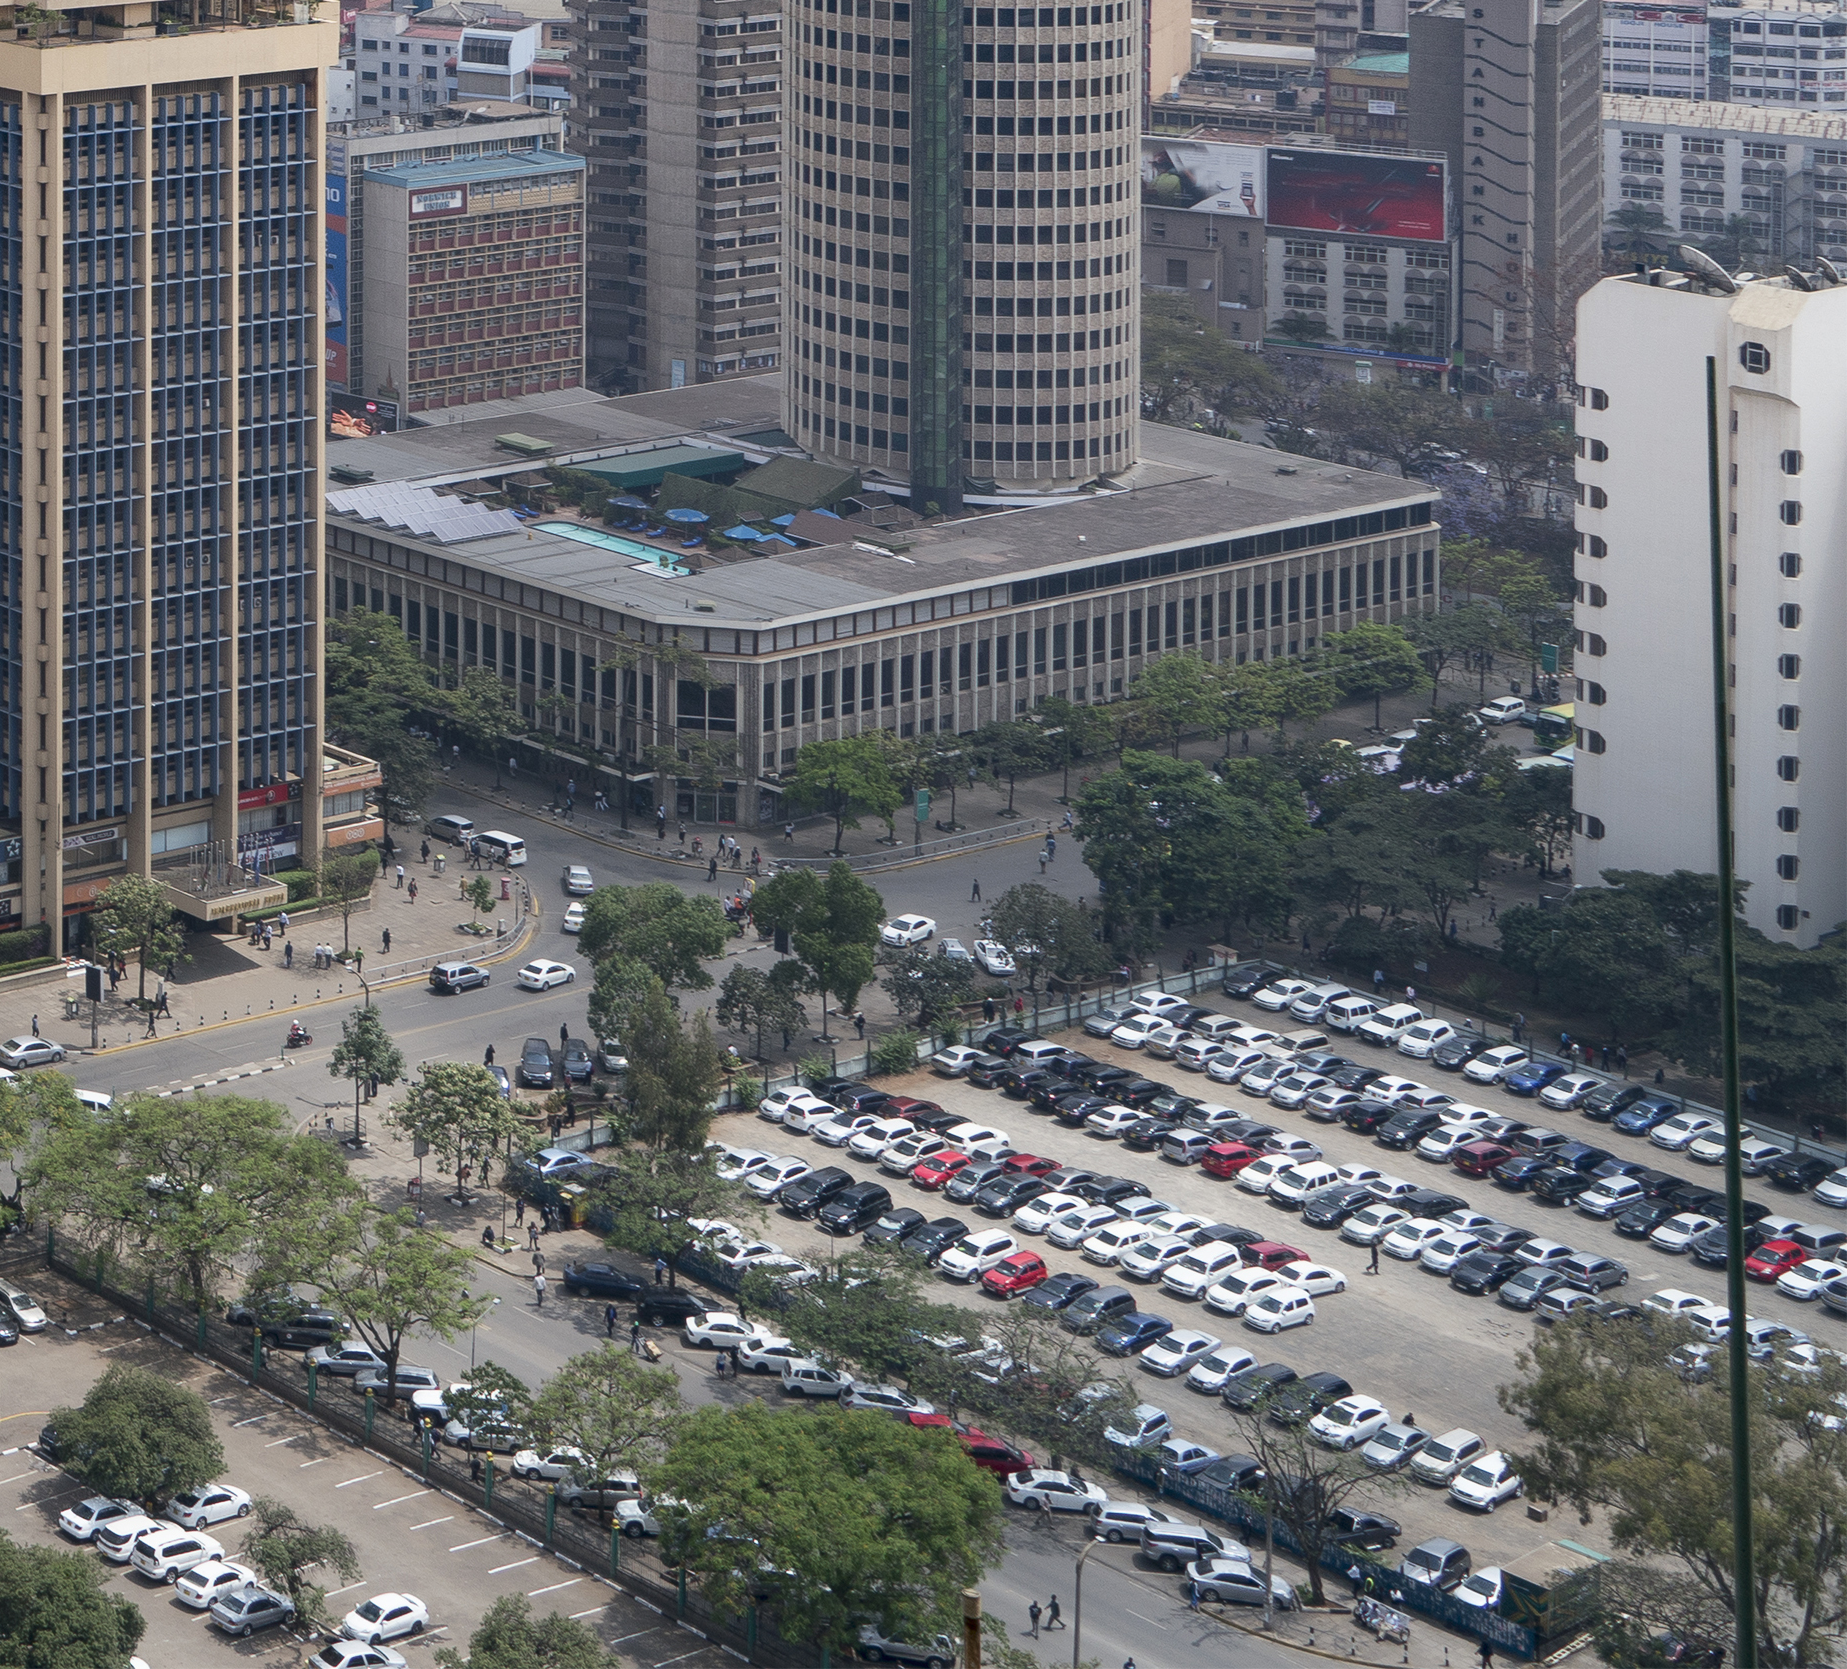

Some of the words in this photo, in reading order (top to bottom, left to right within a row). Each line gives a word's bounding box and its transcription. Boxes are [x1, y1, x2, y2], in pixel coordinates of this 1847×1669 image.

[1472, 8, 1485, 226] STANBANK
[416, 193, 457, 203] NORWICH
[423, 200, 451, 211] UNION
